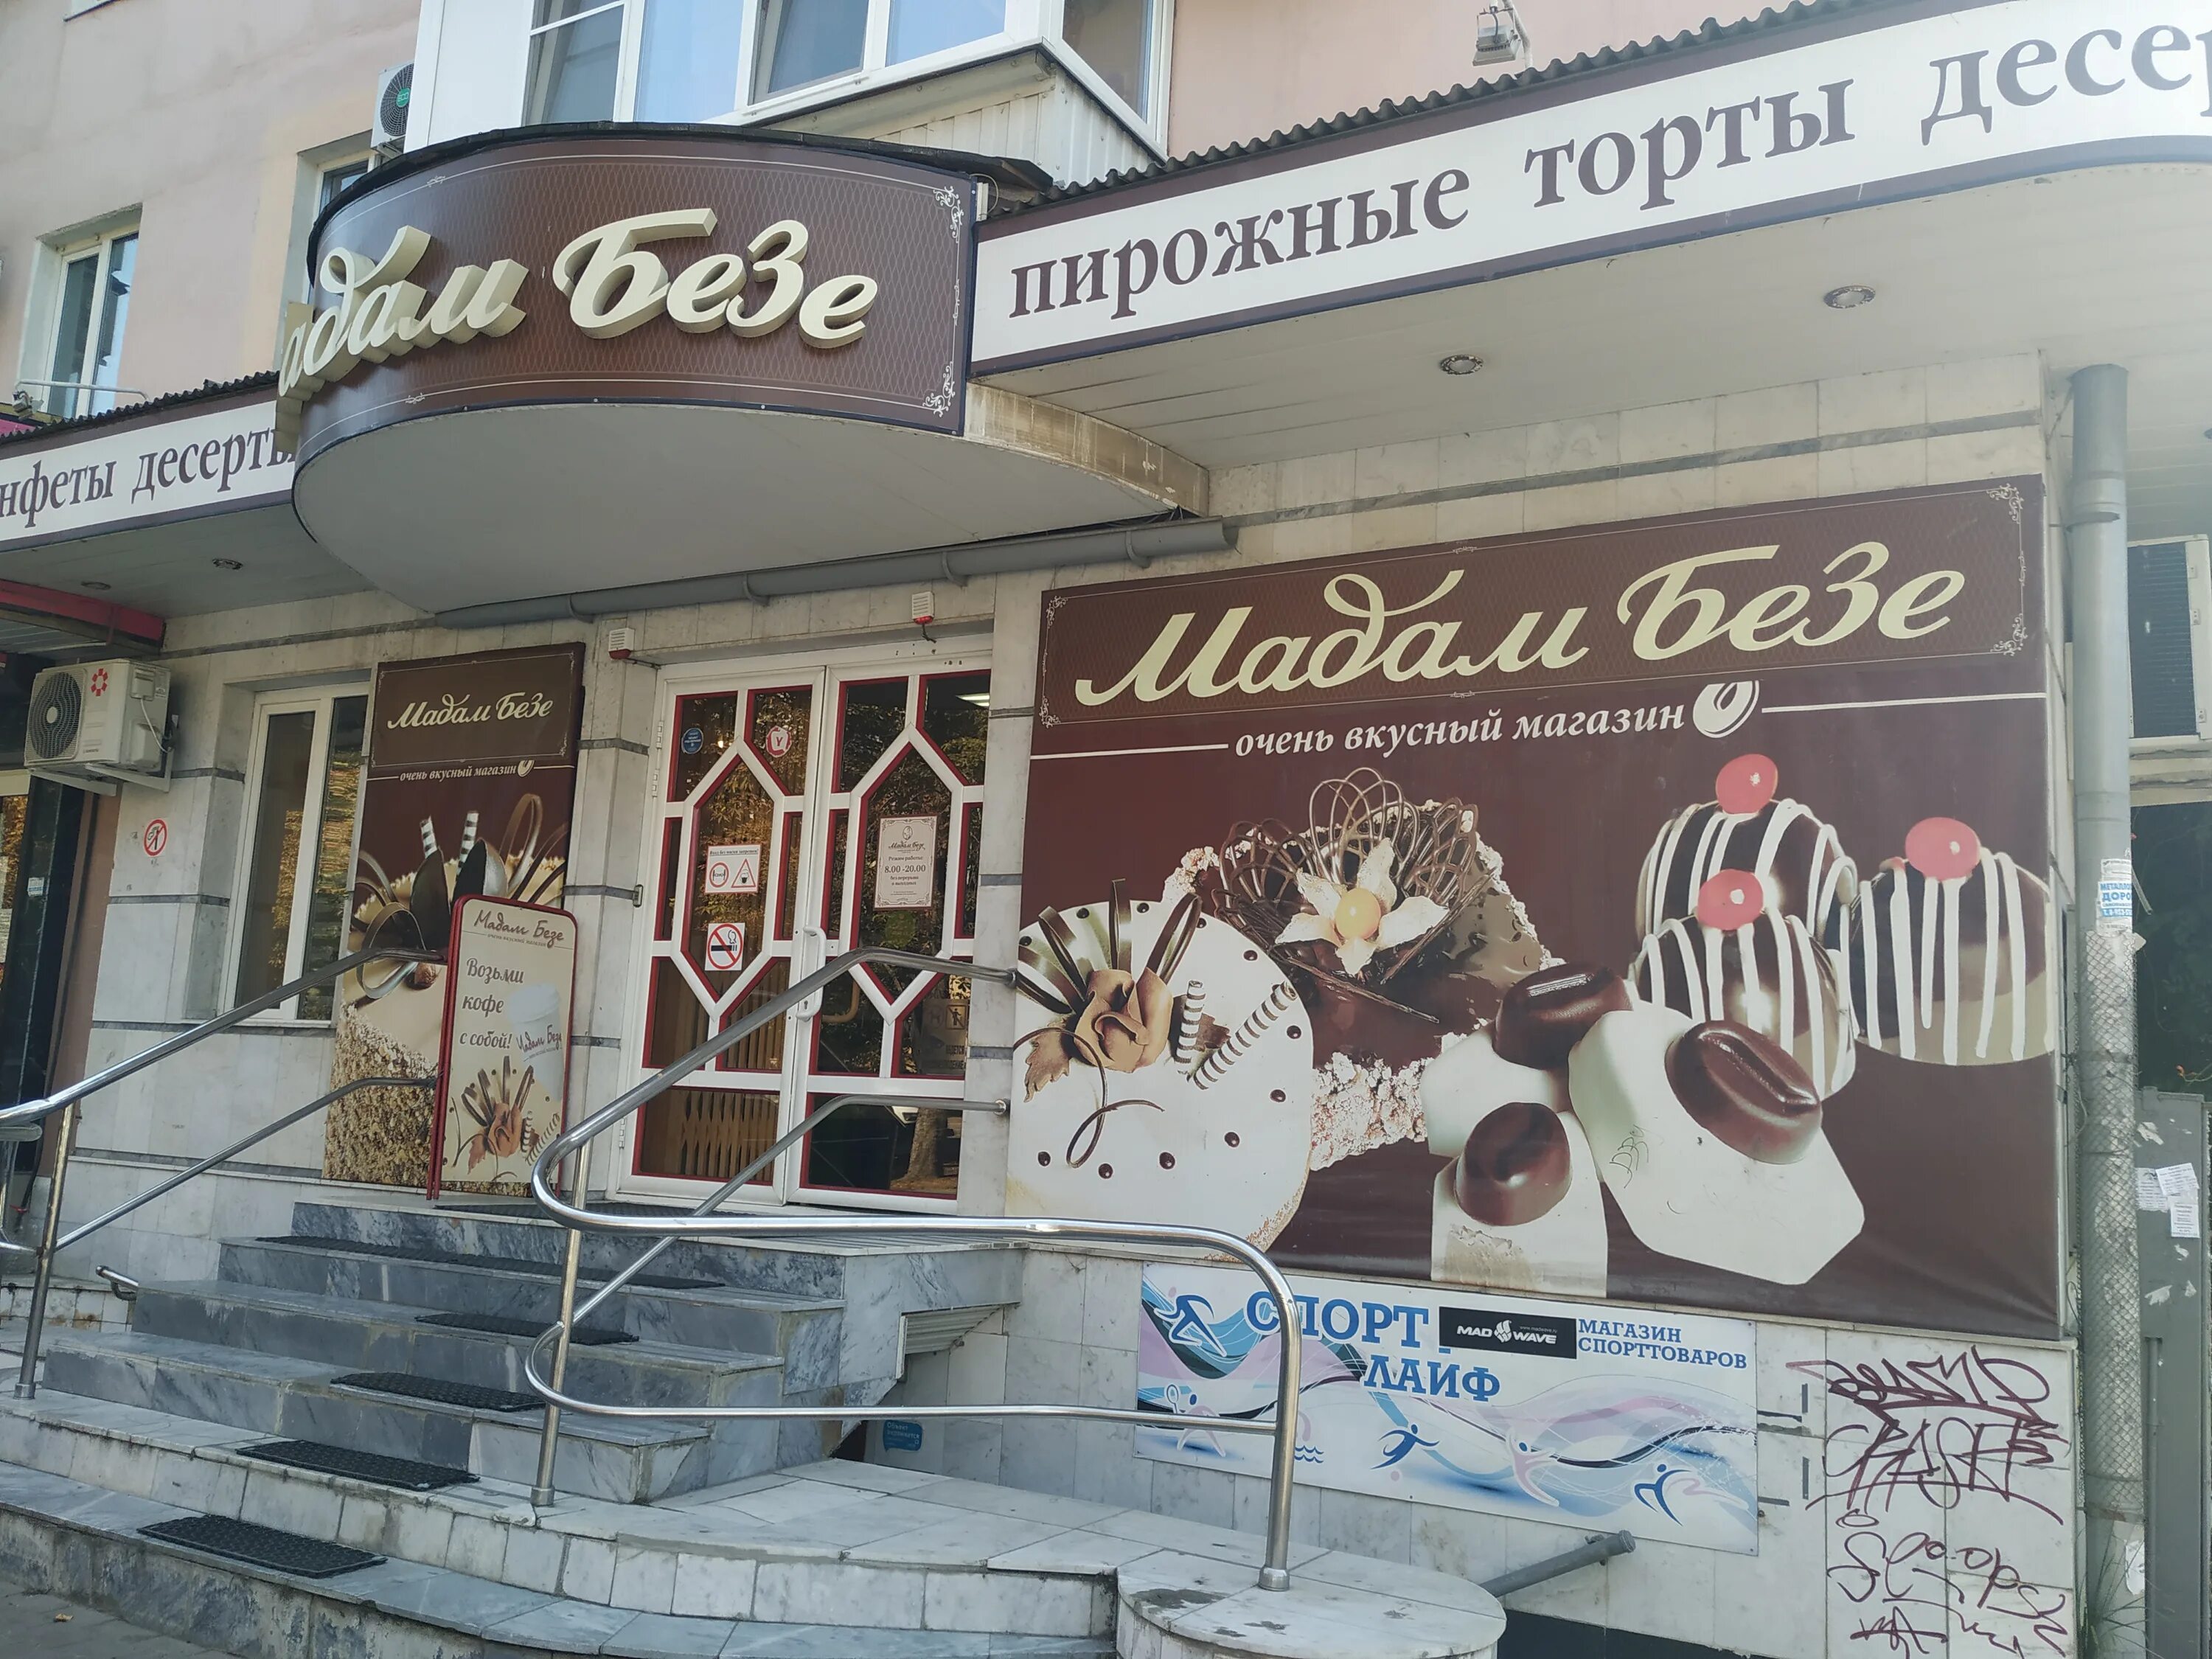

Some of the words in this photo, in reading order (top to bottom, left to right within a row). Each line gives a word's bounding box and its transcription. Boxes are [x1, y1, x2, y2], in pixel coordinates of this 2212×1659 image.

[1009, 168, 1469, 320] пирожные
[1525, 78, 1855, 211] торты
[1921, 24, 2212, 146] десе
[276, 225, 528, 402] адам
[1075, 569, 1590, 706] Мадам
[387, 694, 490, 729] Мадам
[1235, 729, 1334, 757] очень
[1345, 708, 1503, 757] вкусный
[1512, 703, 1686, 740] магазин
[400, 771, 427, 782] очень
[429, 765, 472, 782] вкусный
[474, 765, 517, 776] магазин
[884, 865, 900, 874] 8.00
[474, 909, 529, 935] Мадам
[532, 920, 564, 948] Безе
[466, 958, 524, 984] Возьми
[462, 995, 504, 1018] кофе
[459, 1032, 467, 1045] с
[470, 1031, 512, 1049] собой!
[1457, 1325, 1492, 1338] MAD
[1513, 1331, 1557, 1345] WAVE
[1579, 1318, 1682, 1343] МАГАЗИН
[1579, 1338, 1748, 1369] СПОРТТОВАРОВ
